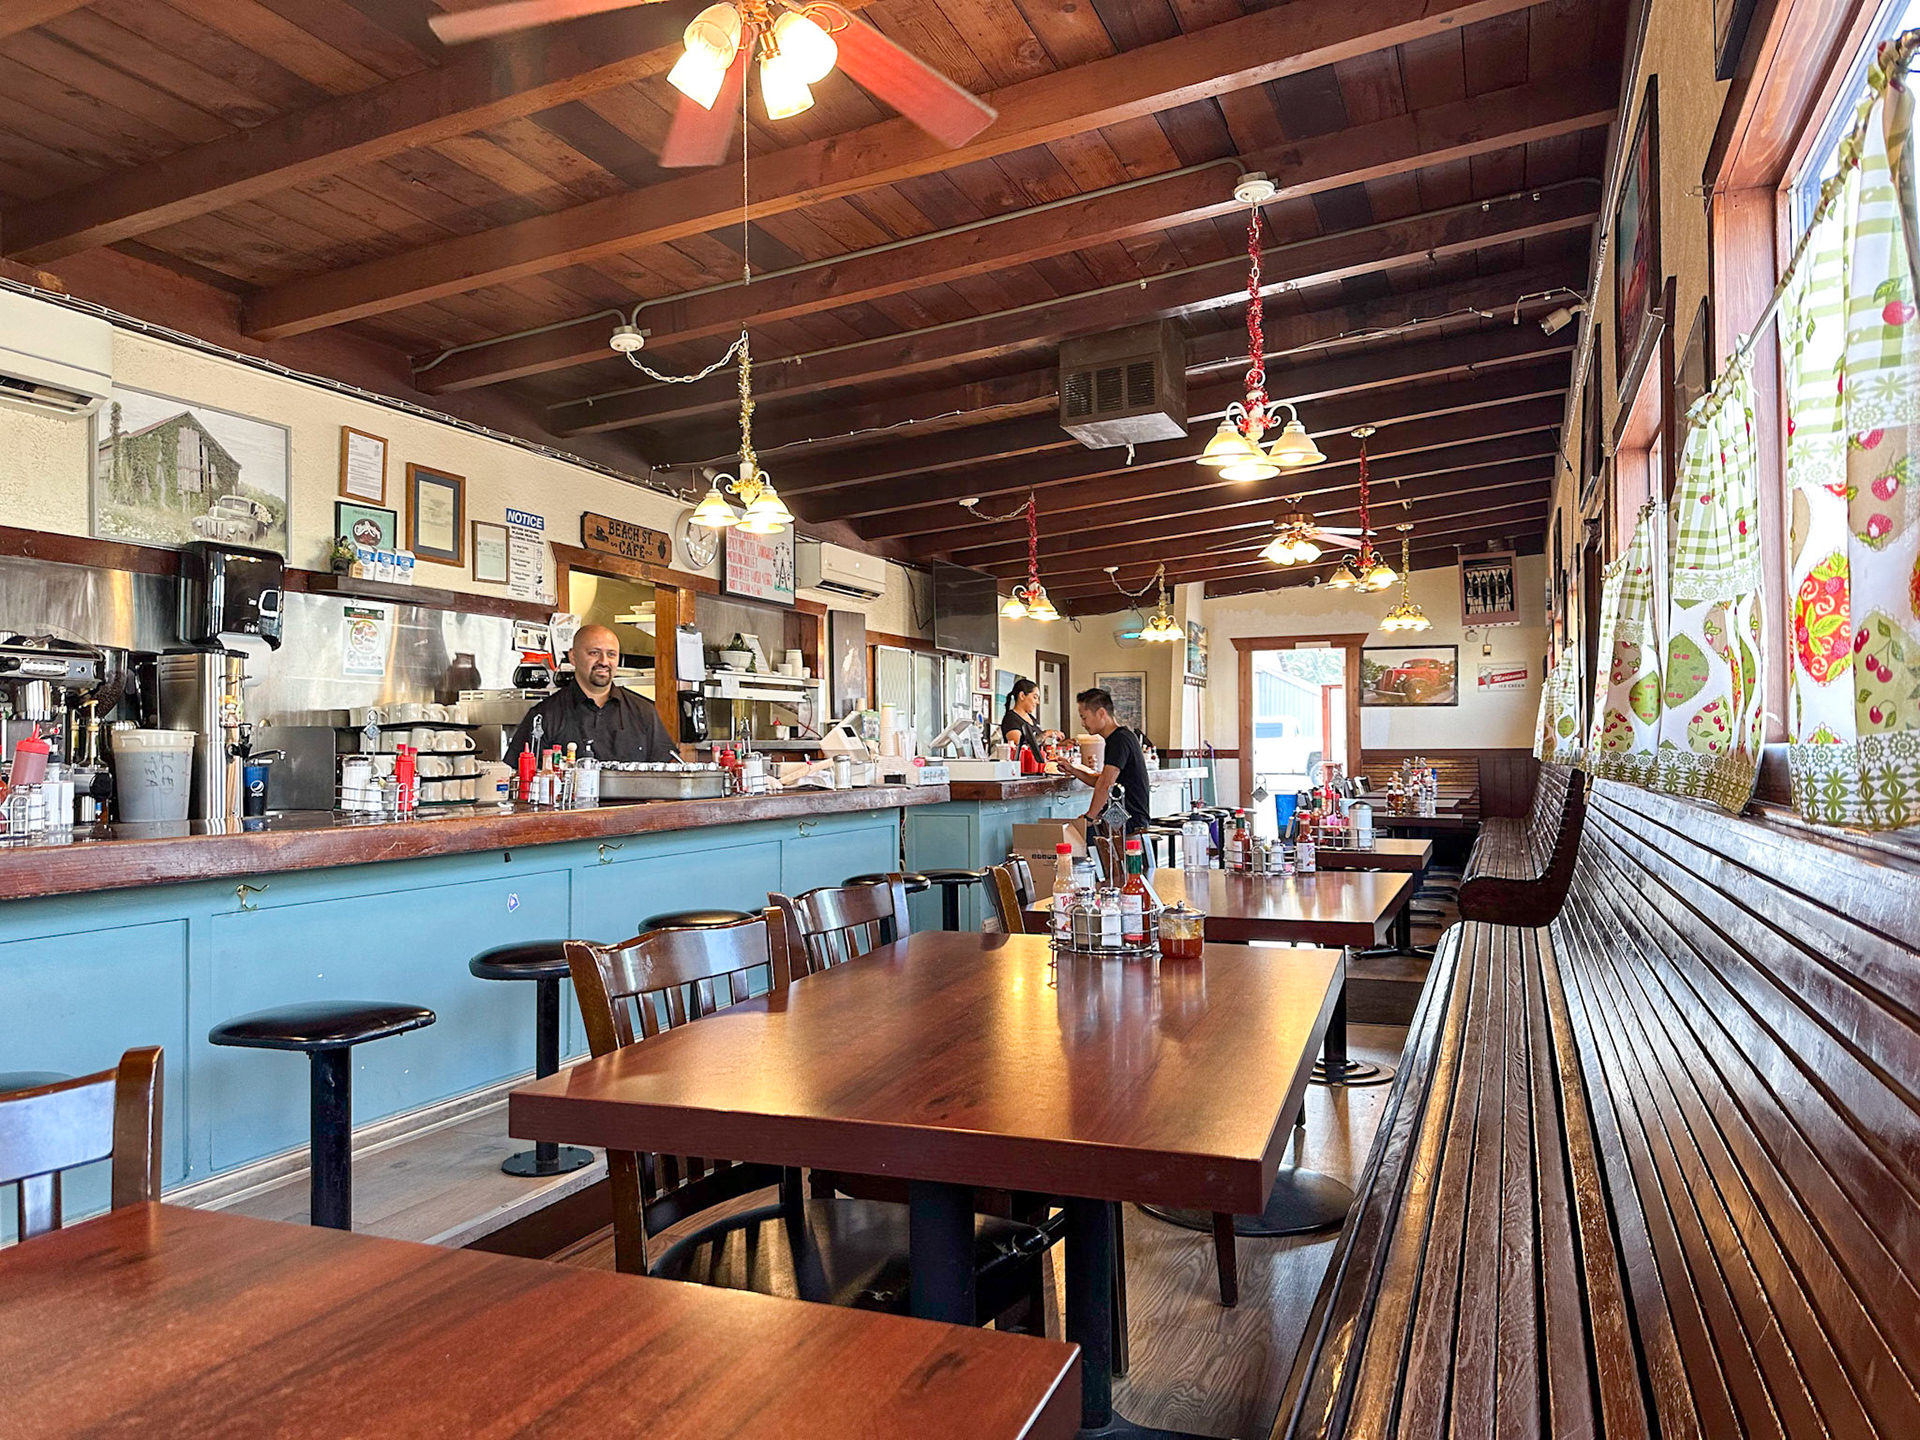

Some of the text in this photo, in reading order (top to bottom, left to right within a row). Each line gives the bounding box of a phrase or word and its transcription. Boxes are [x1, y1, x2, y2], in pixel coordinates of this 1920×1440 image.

[507, 510, 543, 528] NOTICE
[608, 521, 654, 546] BEACH ST.
[618, 540, 645, 559] CAFE
[144, 756, 158, 787] TEA
[160, 751, 175, 793] ICED
